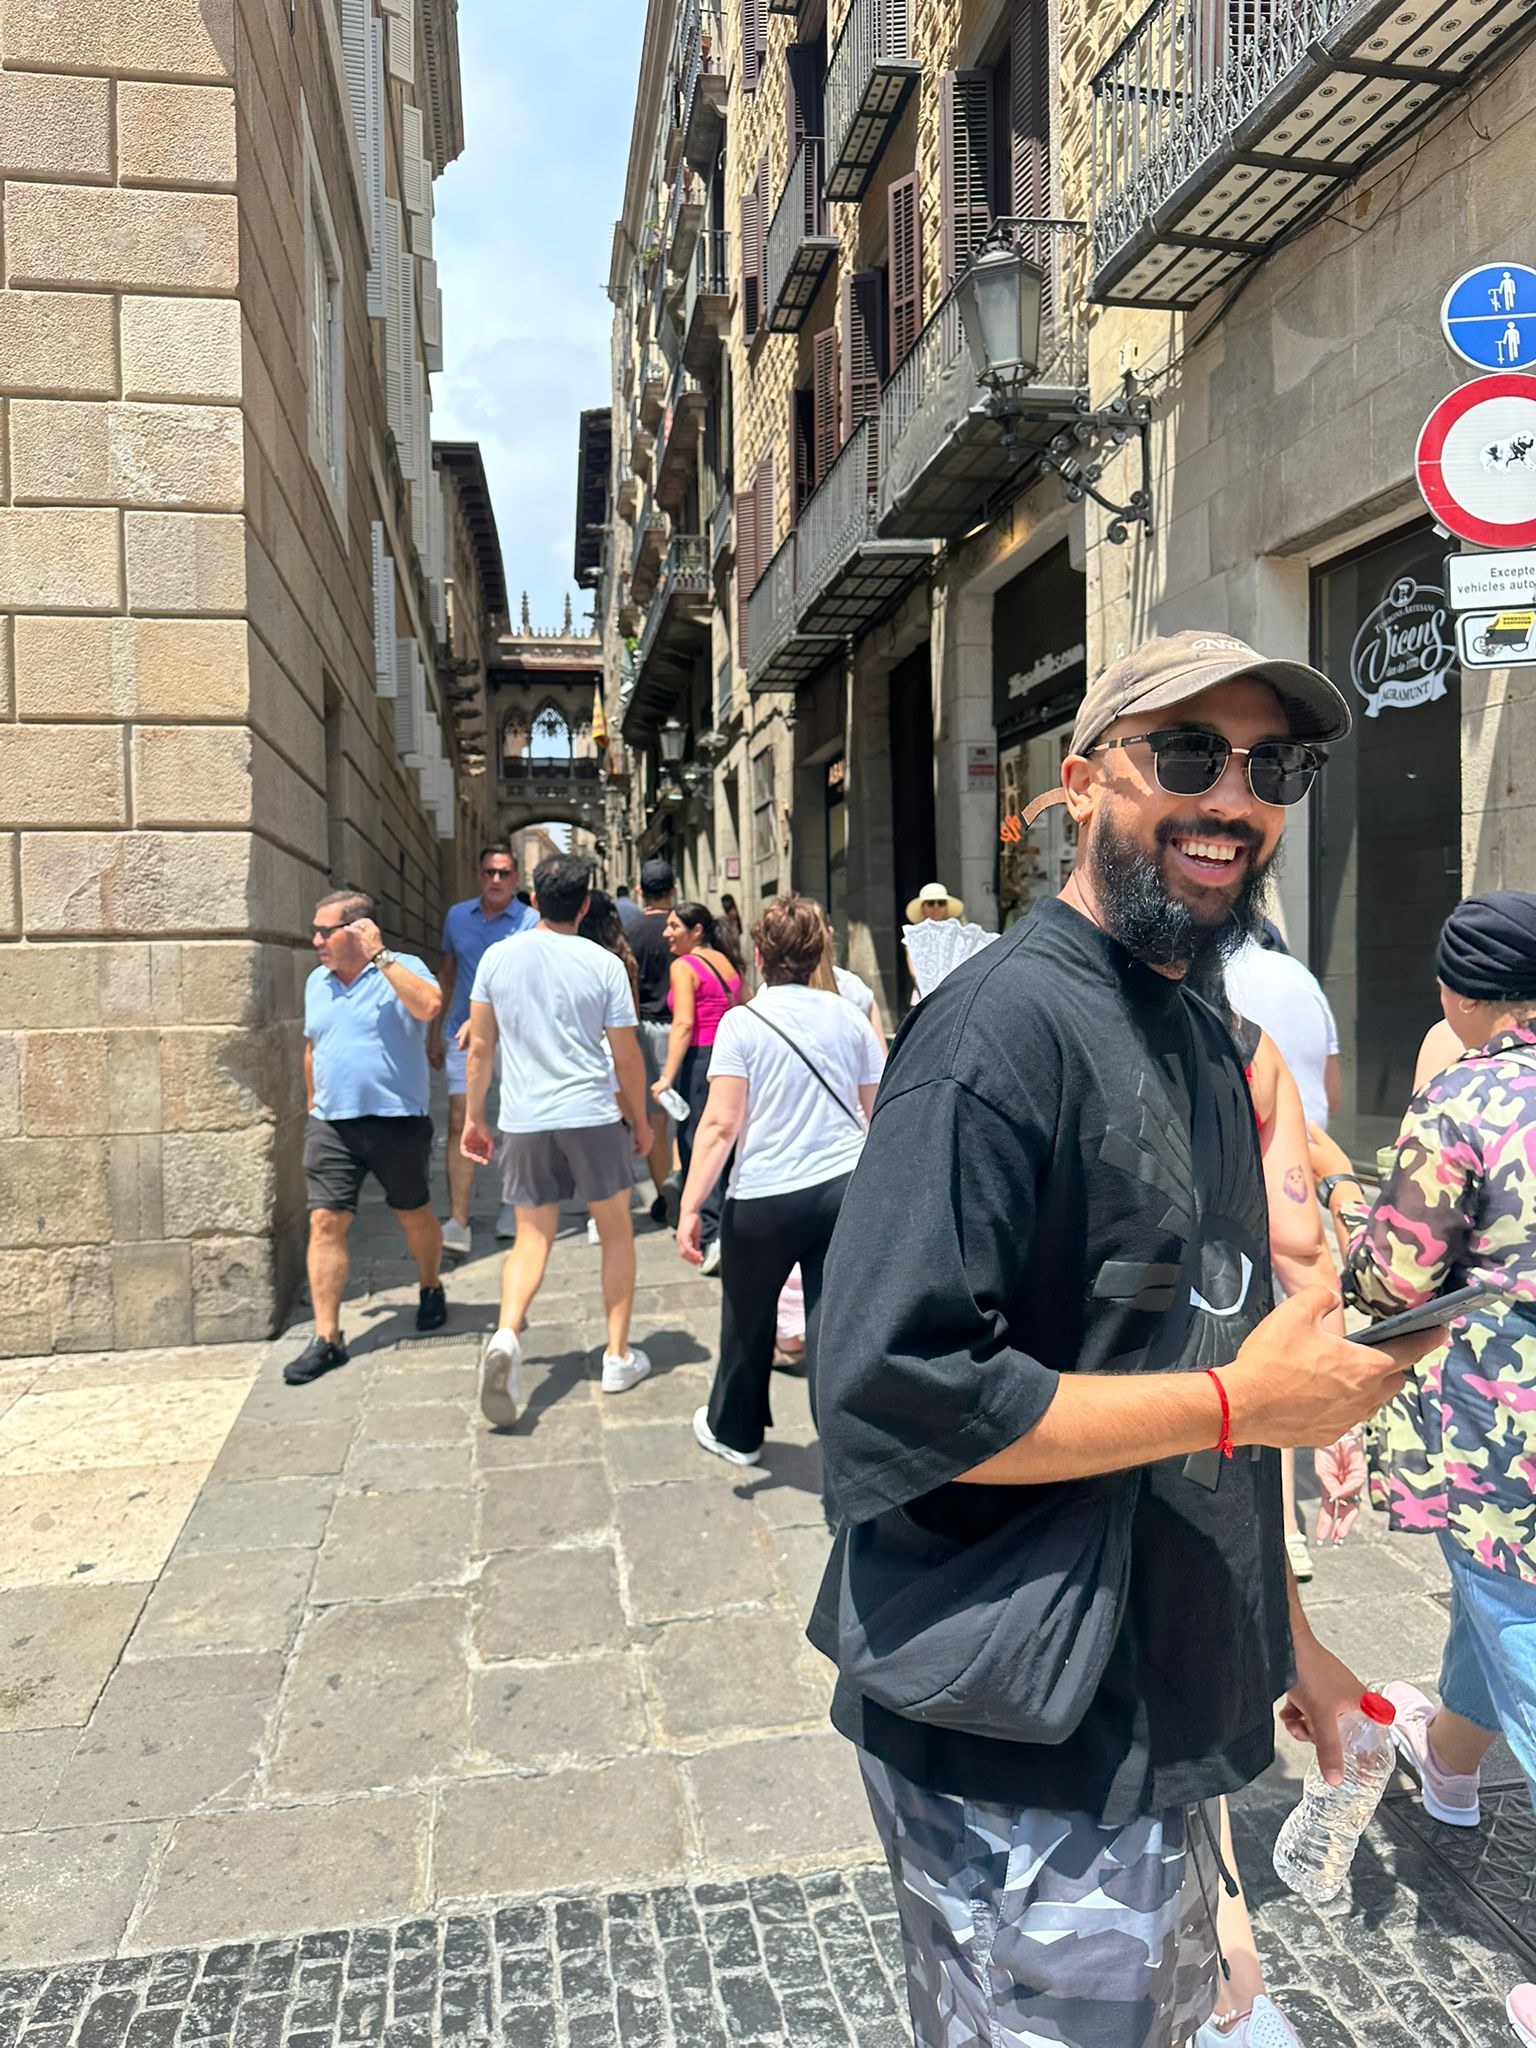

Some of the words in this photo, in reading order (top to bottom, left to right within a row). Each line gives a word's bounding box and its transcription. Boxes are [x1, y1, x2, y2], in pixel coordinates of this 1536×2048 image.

[1490, 566, 1536, 578] Excepte
[1457, 581, 1506, 594] vehicles
[1403, 604, 1436, 615] ARTESANS
[1358, 609, 1452, 685] Vicens
[1380, 681, 1430, 702] AGRAMUNT
